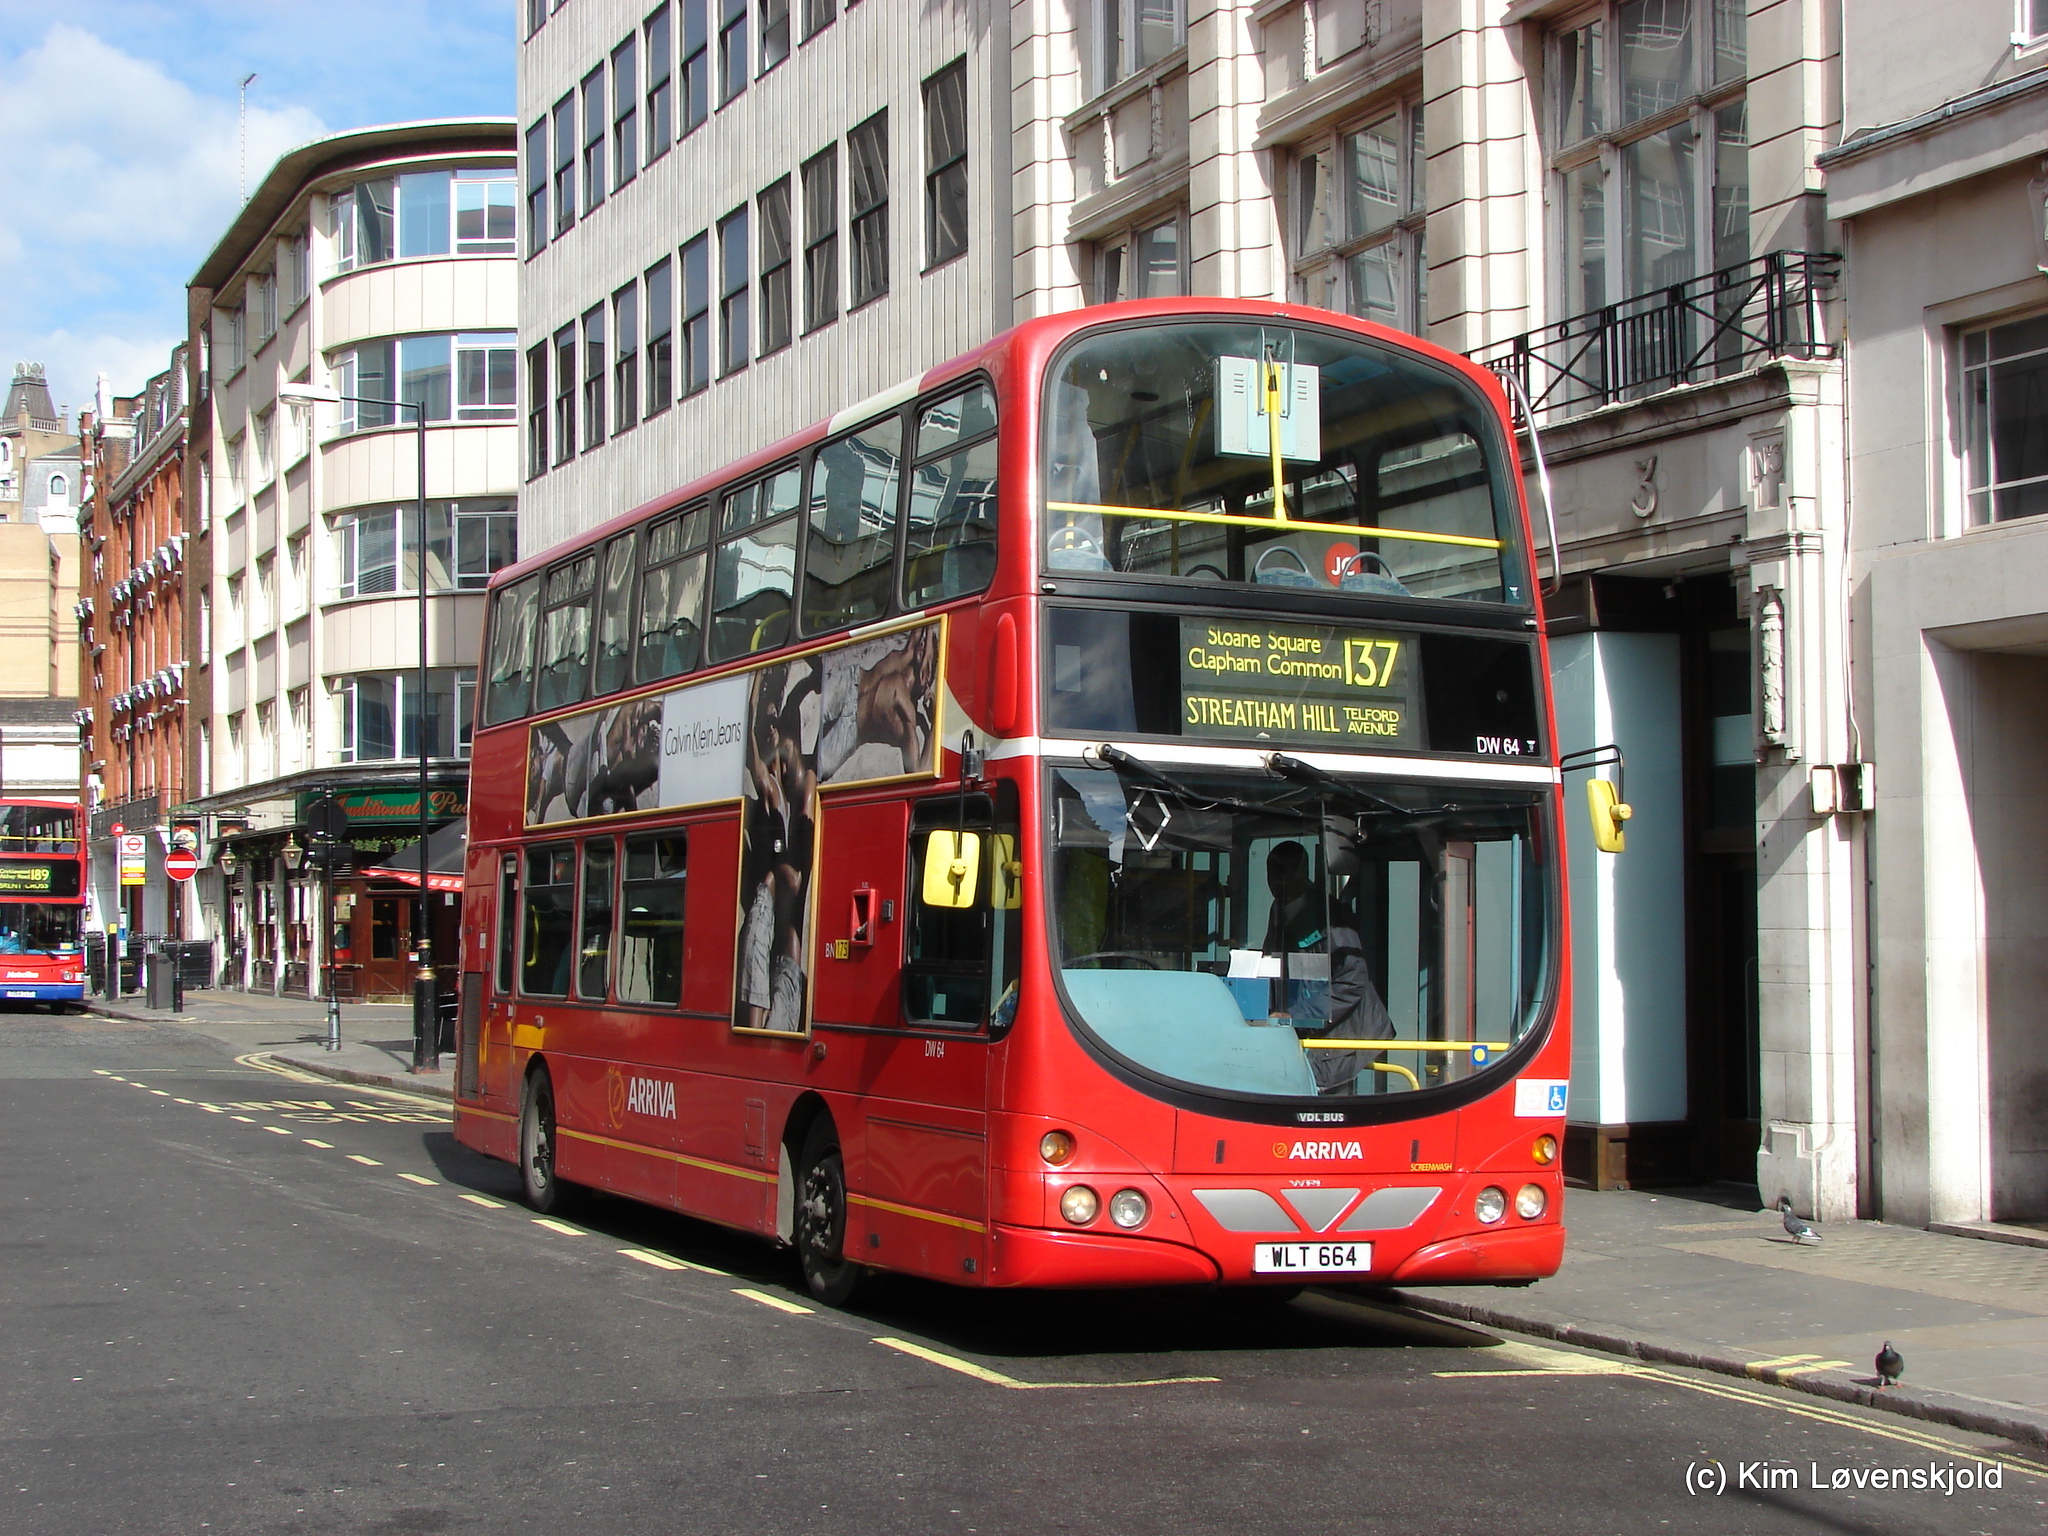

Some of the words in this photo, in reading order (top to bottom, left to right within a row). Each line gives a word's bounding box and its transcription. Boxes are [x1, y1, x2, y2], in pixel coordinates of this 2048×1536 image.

[1632, 455, 1658, 518] 3
[1207, 626, 1261, 649] Sloane
[1267, 631, 1321, 656] Square
[1188, 647, 1261, 676] Clapham
[1266, 654, 1342, 679] Common
[1343, 637, 1399, 688] 137
[1186, 697, 1296, 730] STREATHAM
[1302, 704, 1341, 733] HILL
[1342, 706, 1400, 723] TELFORD
[664, 725, 692, 756] Calvin
[692, 720, 714, 751] Klein
[713, 716, 742, 747] Jeans
[1347, 721, 1398, 736] AVENUE
[1476, 736, 1500, 754] DW
[1503, 738, 1520, 755] 64
[429, 790, 468, 815] Pu
[30, 868, 50, 881] 189
[925, 1040, 936, 1057] DW
[936, 1041, 945, 1058] 64
[627, 1076, 677, 1120] ARRIVA
[1297, 1112, 1322, 1122] VDL
[1323, 1112, 1345, 1122] BUS
[1288, 1141, 1364, 1160] ARRIVA
[1410, 1163, 1453, 1172] SCREENWASH
[1272, 1246, 1310, 1267] WLT
[1319, 1246, 1357, 1267] 664
